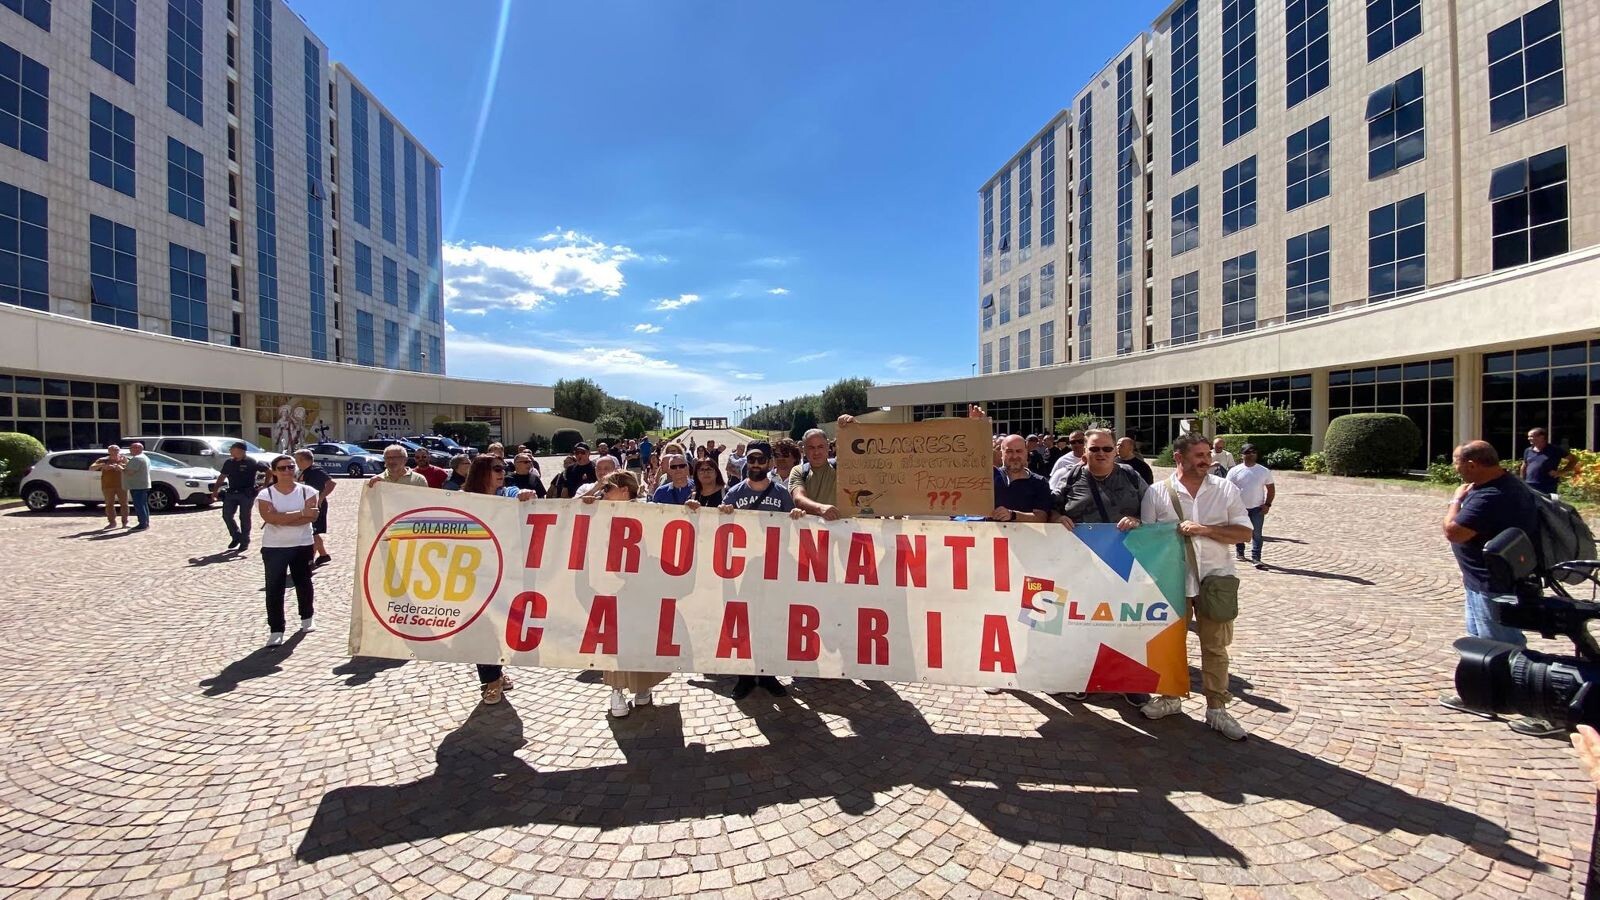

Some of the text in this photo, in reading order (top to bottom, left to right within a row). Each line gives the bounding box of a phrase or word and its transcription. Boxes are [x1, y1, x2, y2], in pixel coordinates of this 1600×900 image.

[346, 402, 406, 416] REGIONE
[914, 470, 992, 491] PROMESSE
[736, 495, 782, 508] LOS AELES
[927, 491, 962, 511] ???
[412, 522, 469, 534] CALABRIA
[525, 513, 1011, 592] TIROCINANTI
[383, 536, 482, 602] USB
[1027, 580, 1042, 591] USB
[387, 602, 461, 617] Federazione
[388, 614, 456, 628] del Sociale
[505, 591, 1018, 674] CALABRIA
